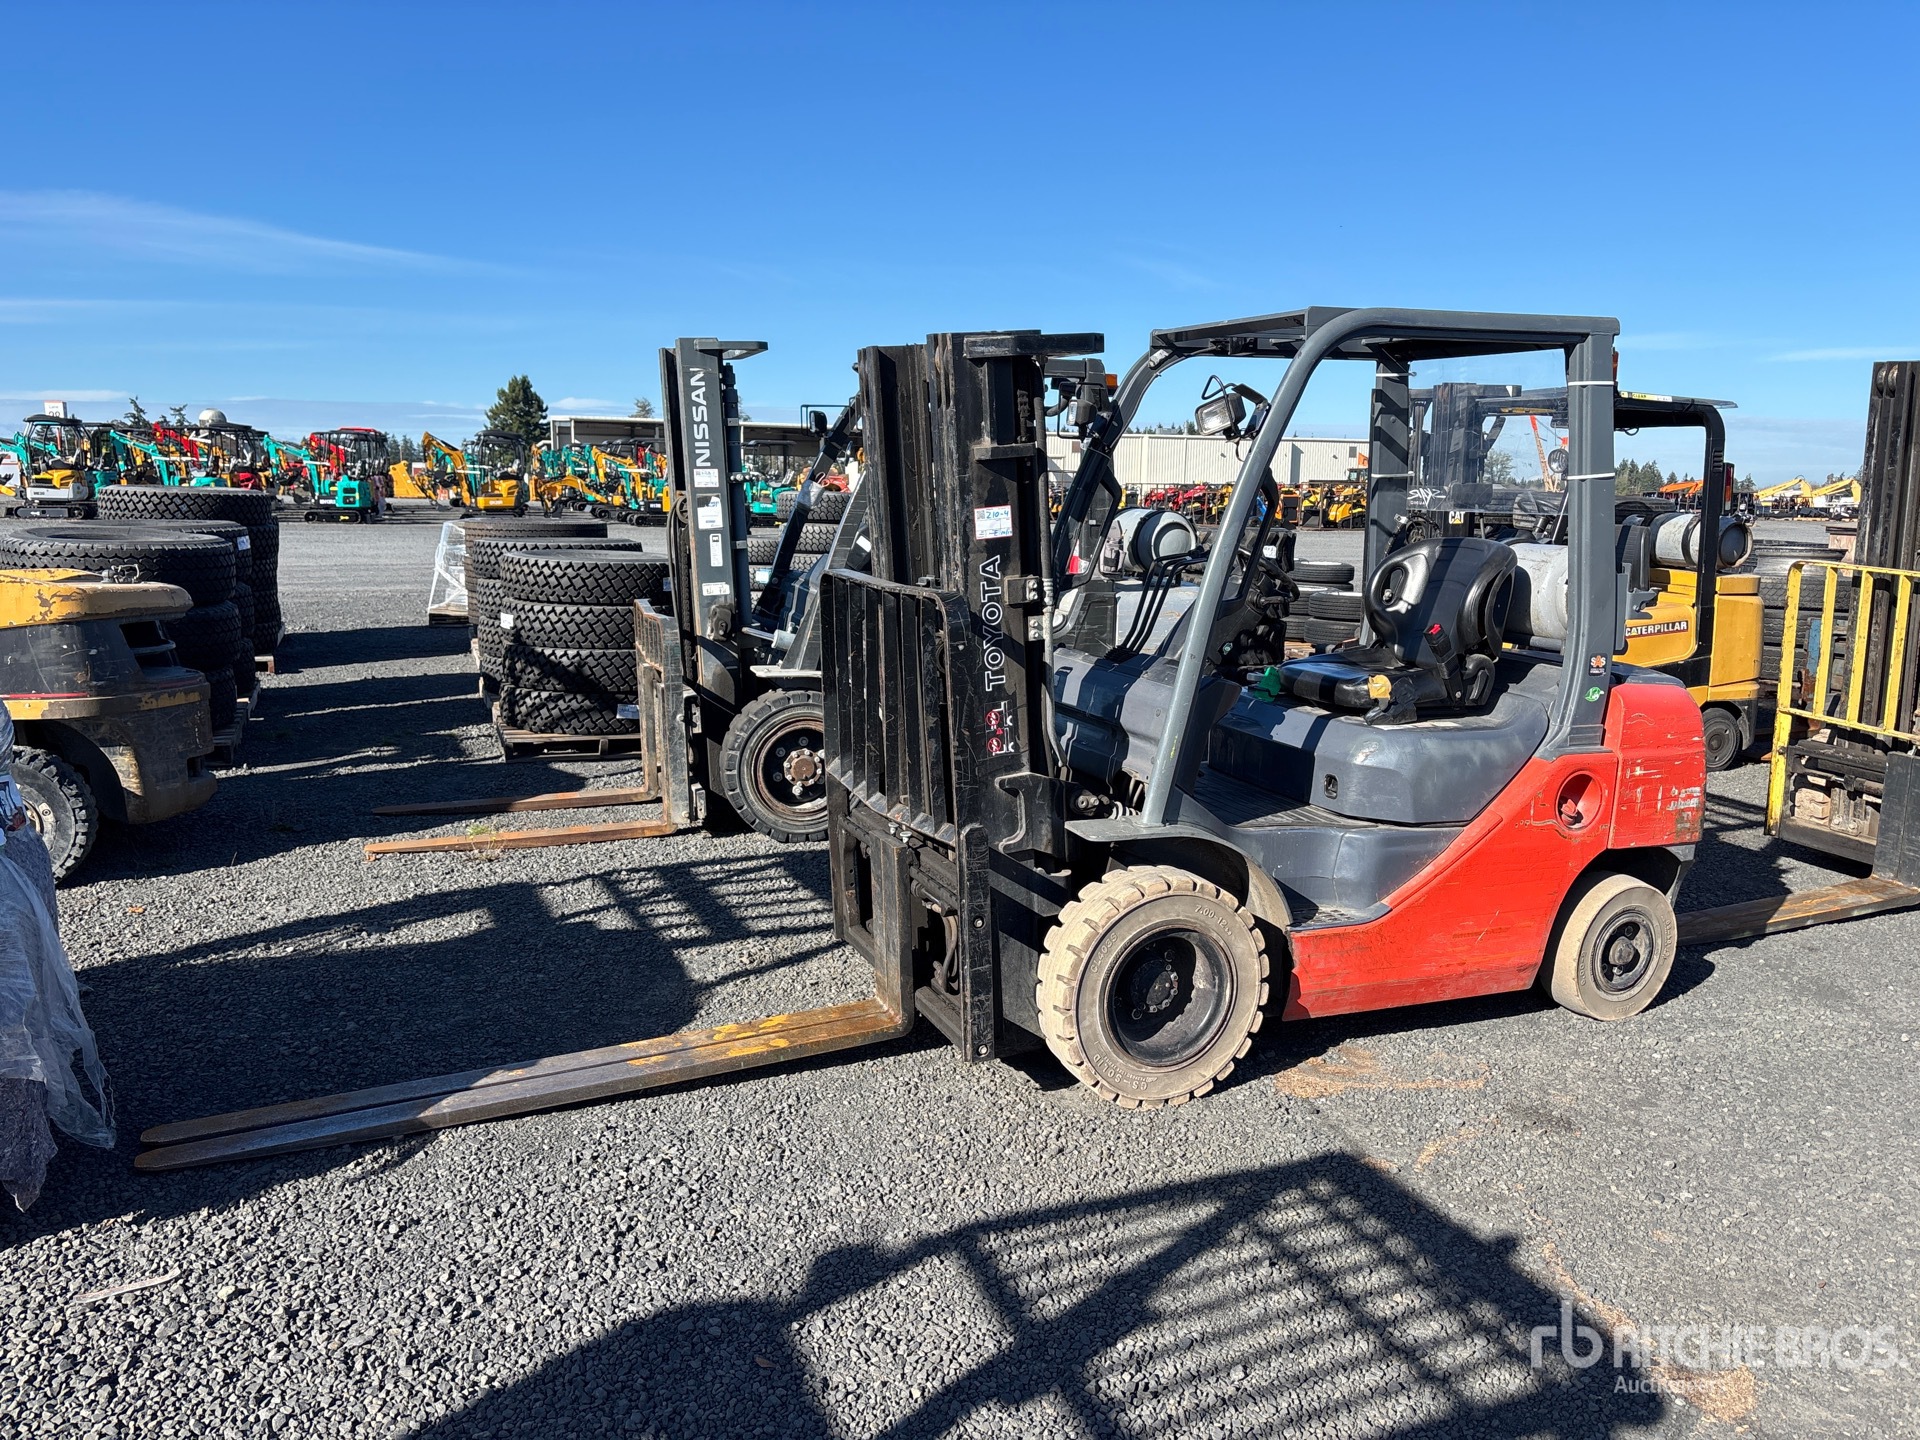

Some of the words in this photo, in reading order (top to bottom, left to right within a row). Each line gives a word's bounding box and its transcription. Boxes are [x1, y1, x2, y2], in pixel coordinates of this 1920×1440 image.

[689, 367, 711, 467] NISSAN
[1448, 510, 1466, 524] CAT
[979, 554, 1006, 691] TOYOTA
[1625, 621, 1687, 637] CATERPILLAR
[1590, 655, 1606, 668] SAS
